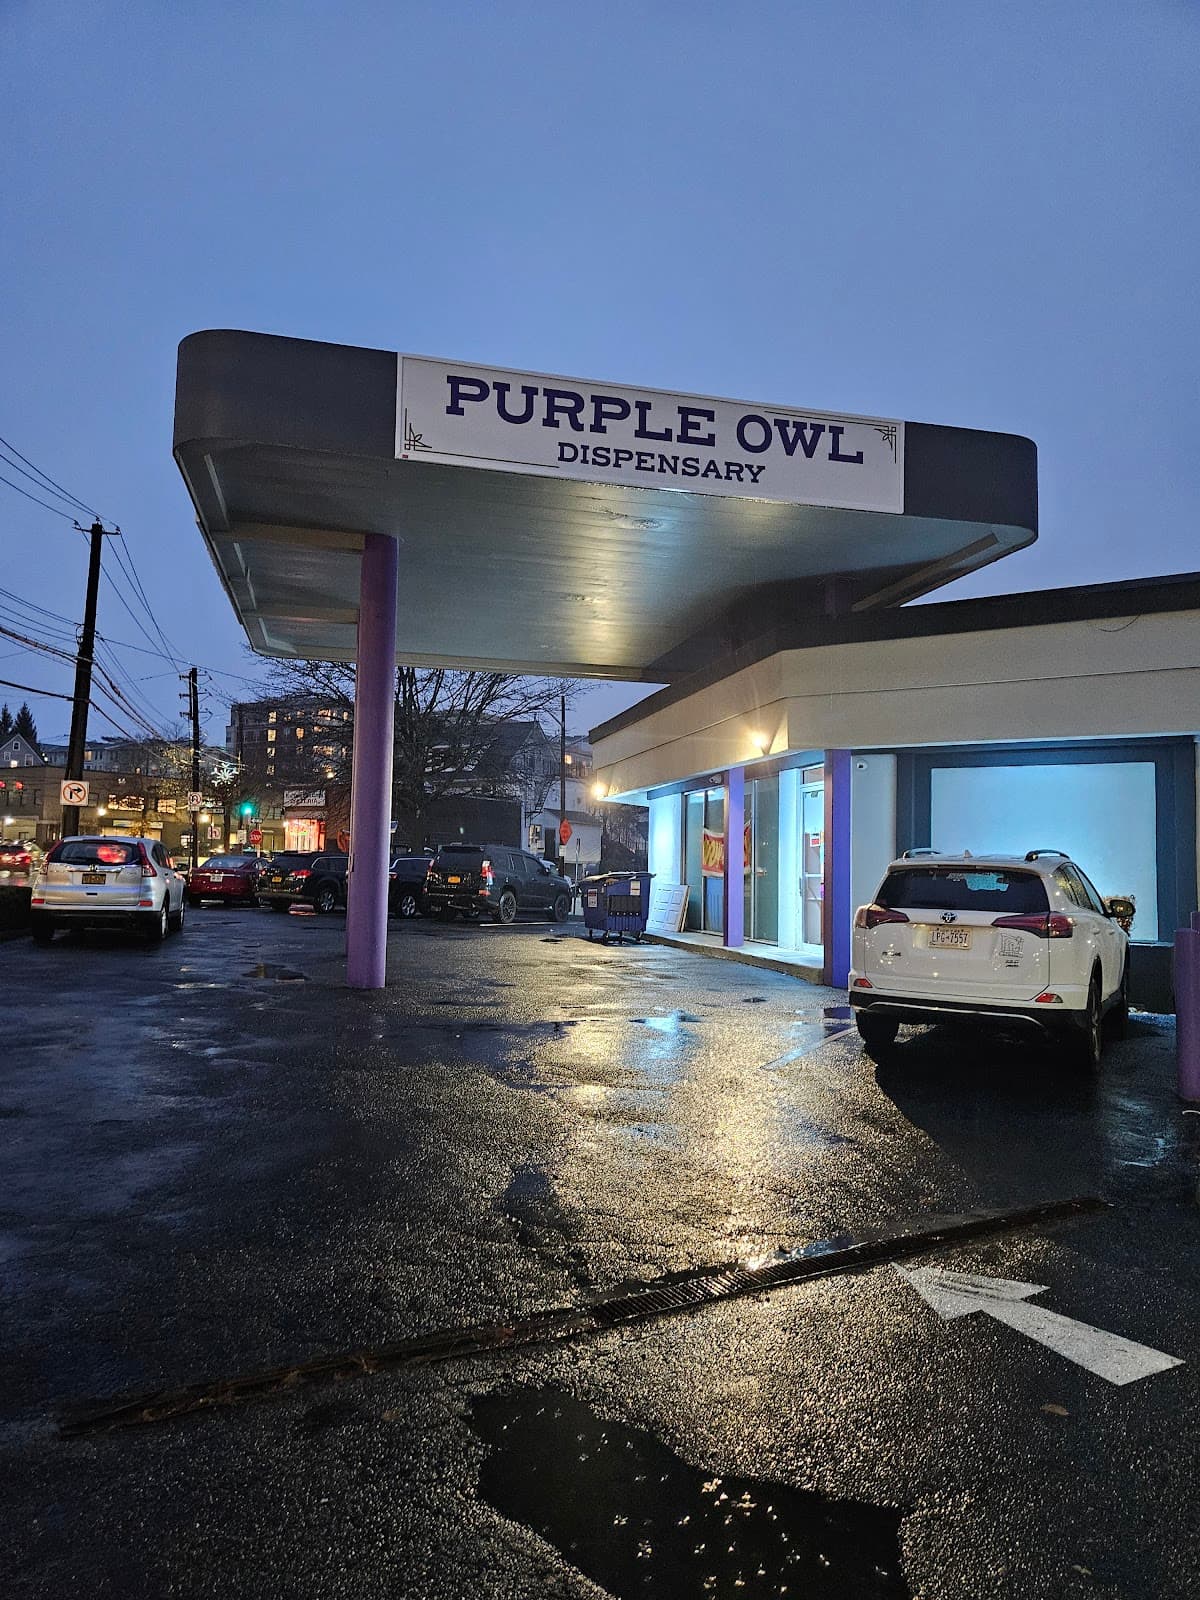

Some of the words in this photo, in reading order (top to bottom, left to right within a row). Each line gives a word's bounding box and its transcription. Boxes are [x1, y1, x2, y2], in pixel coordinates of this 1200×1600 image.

[446, 375, 716, 446] PURPLE
[736, 414, 864, 464] OWL
[557, 441, 766, 483] DISPENSARY
